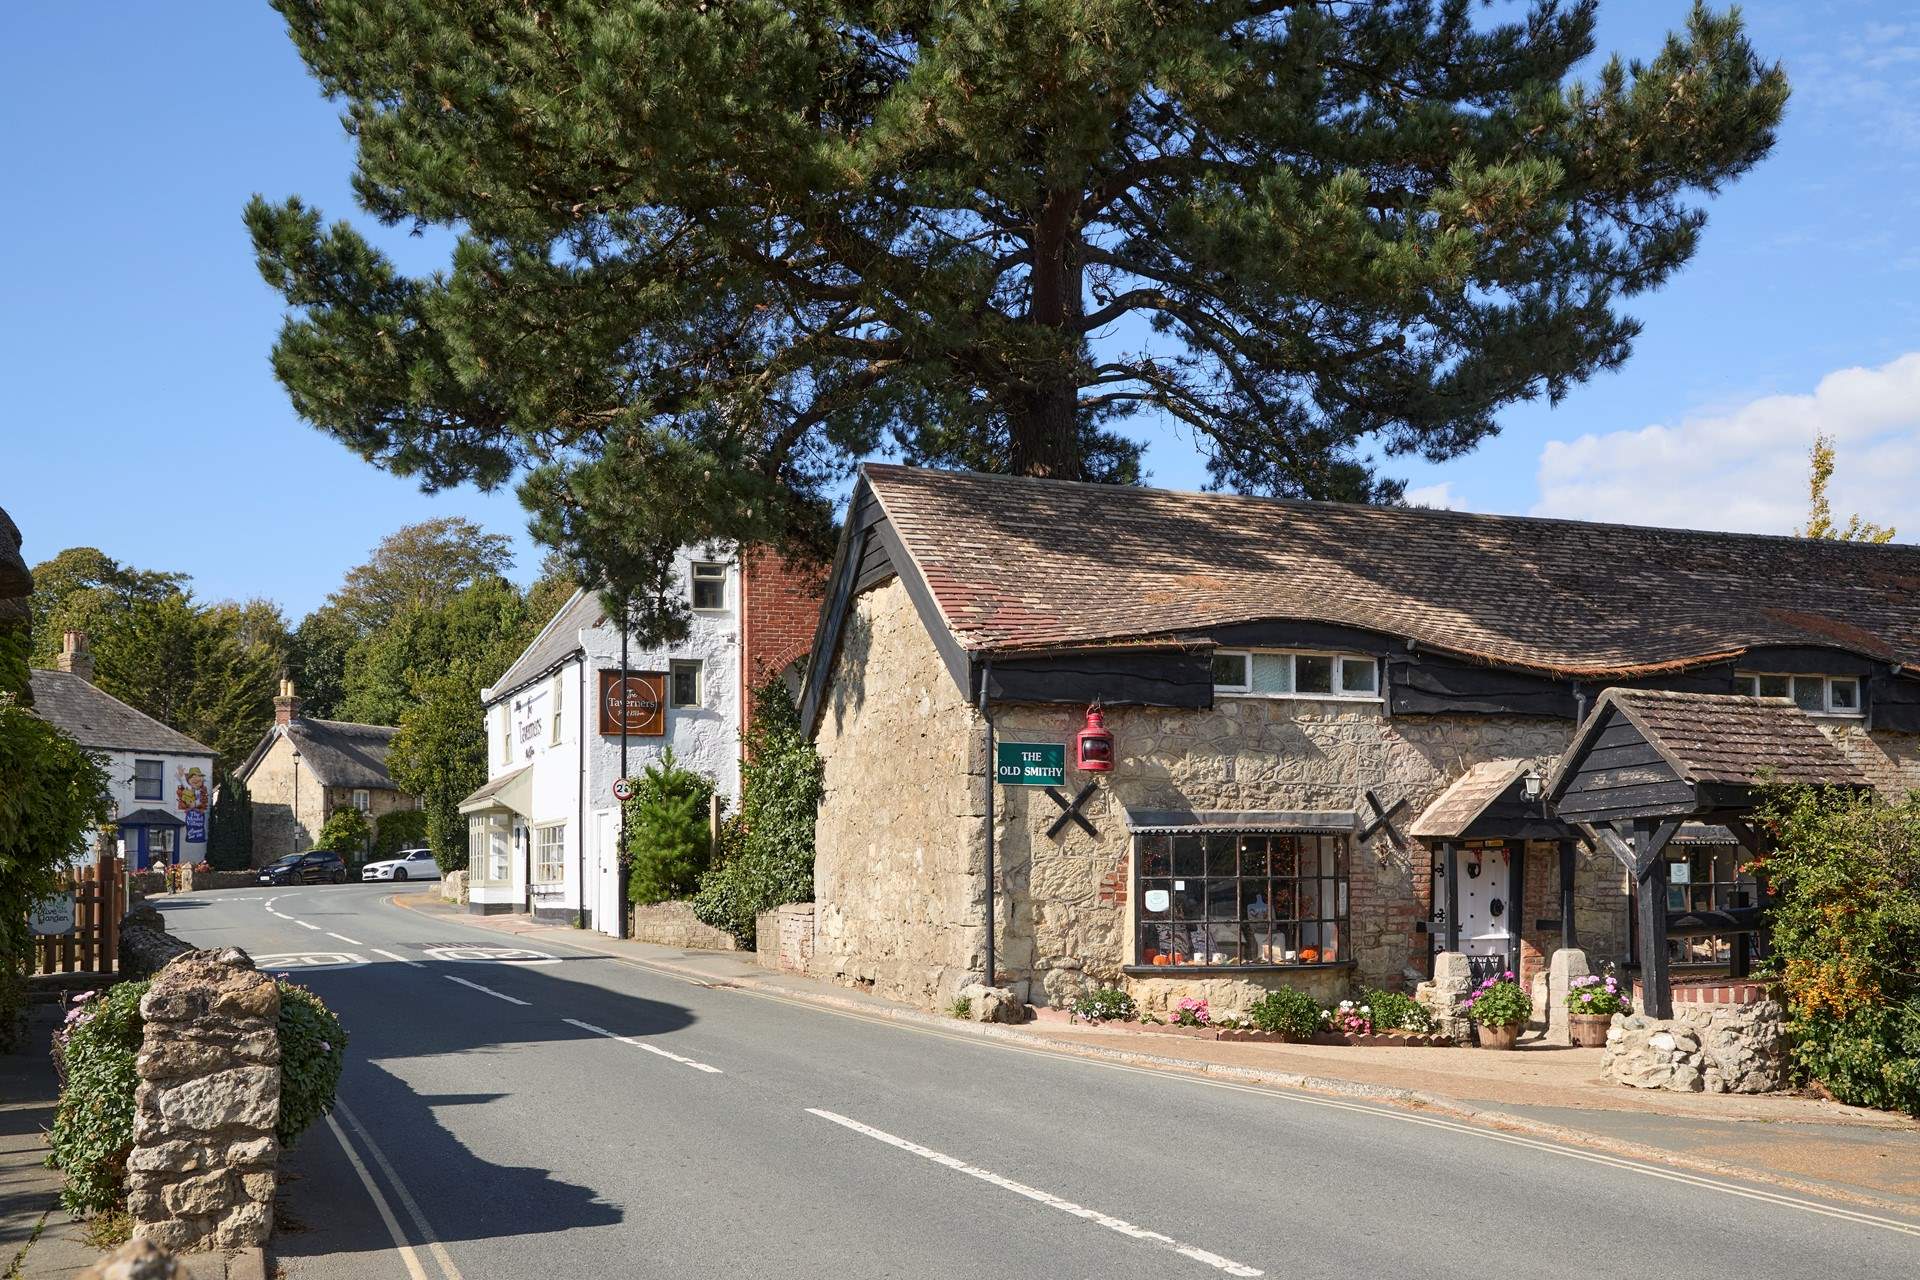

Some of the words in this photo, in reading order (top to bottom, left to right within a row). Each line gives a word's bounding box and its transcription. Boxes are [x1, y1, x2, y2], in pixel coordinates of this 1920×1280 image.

[1021, 751, 1042, 762] THE
[1000, 766, 1021, 776] OLD
[1024, 766, 1063, 777] SMITHY
